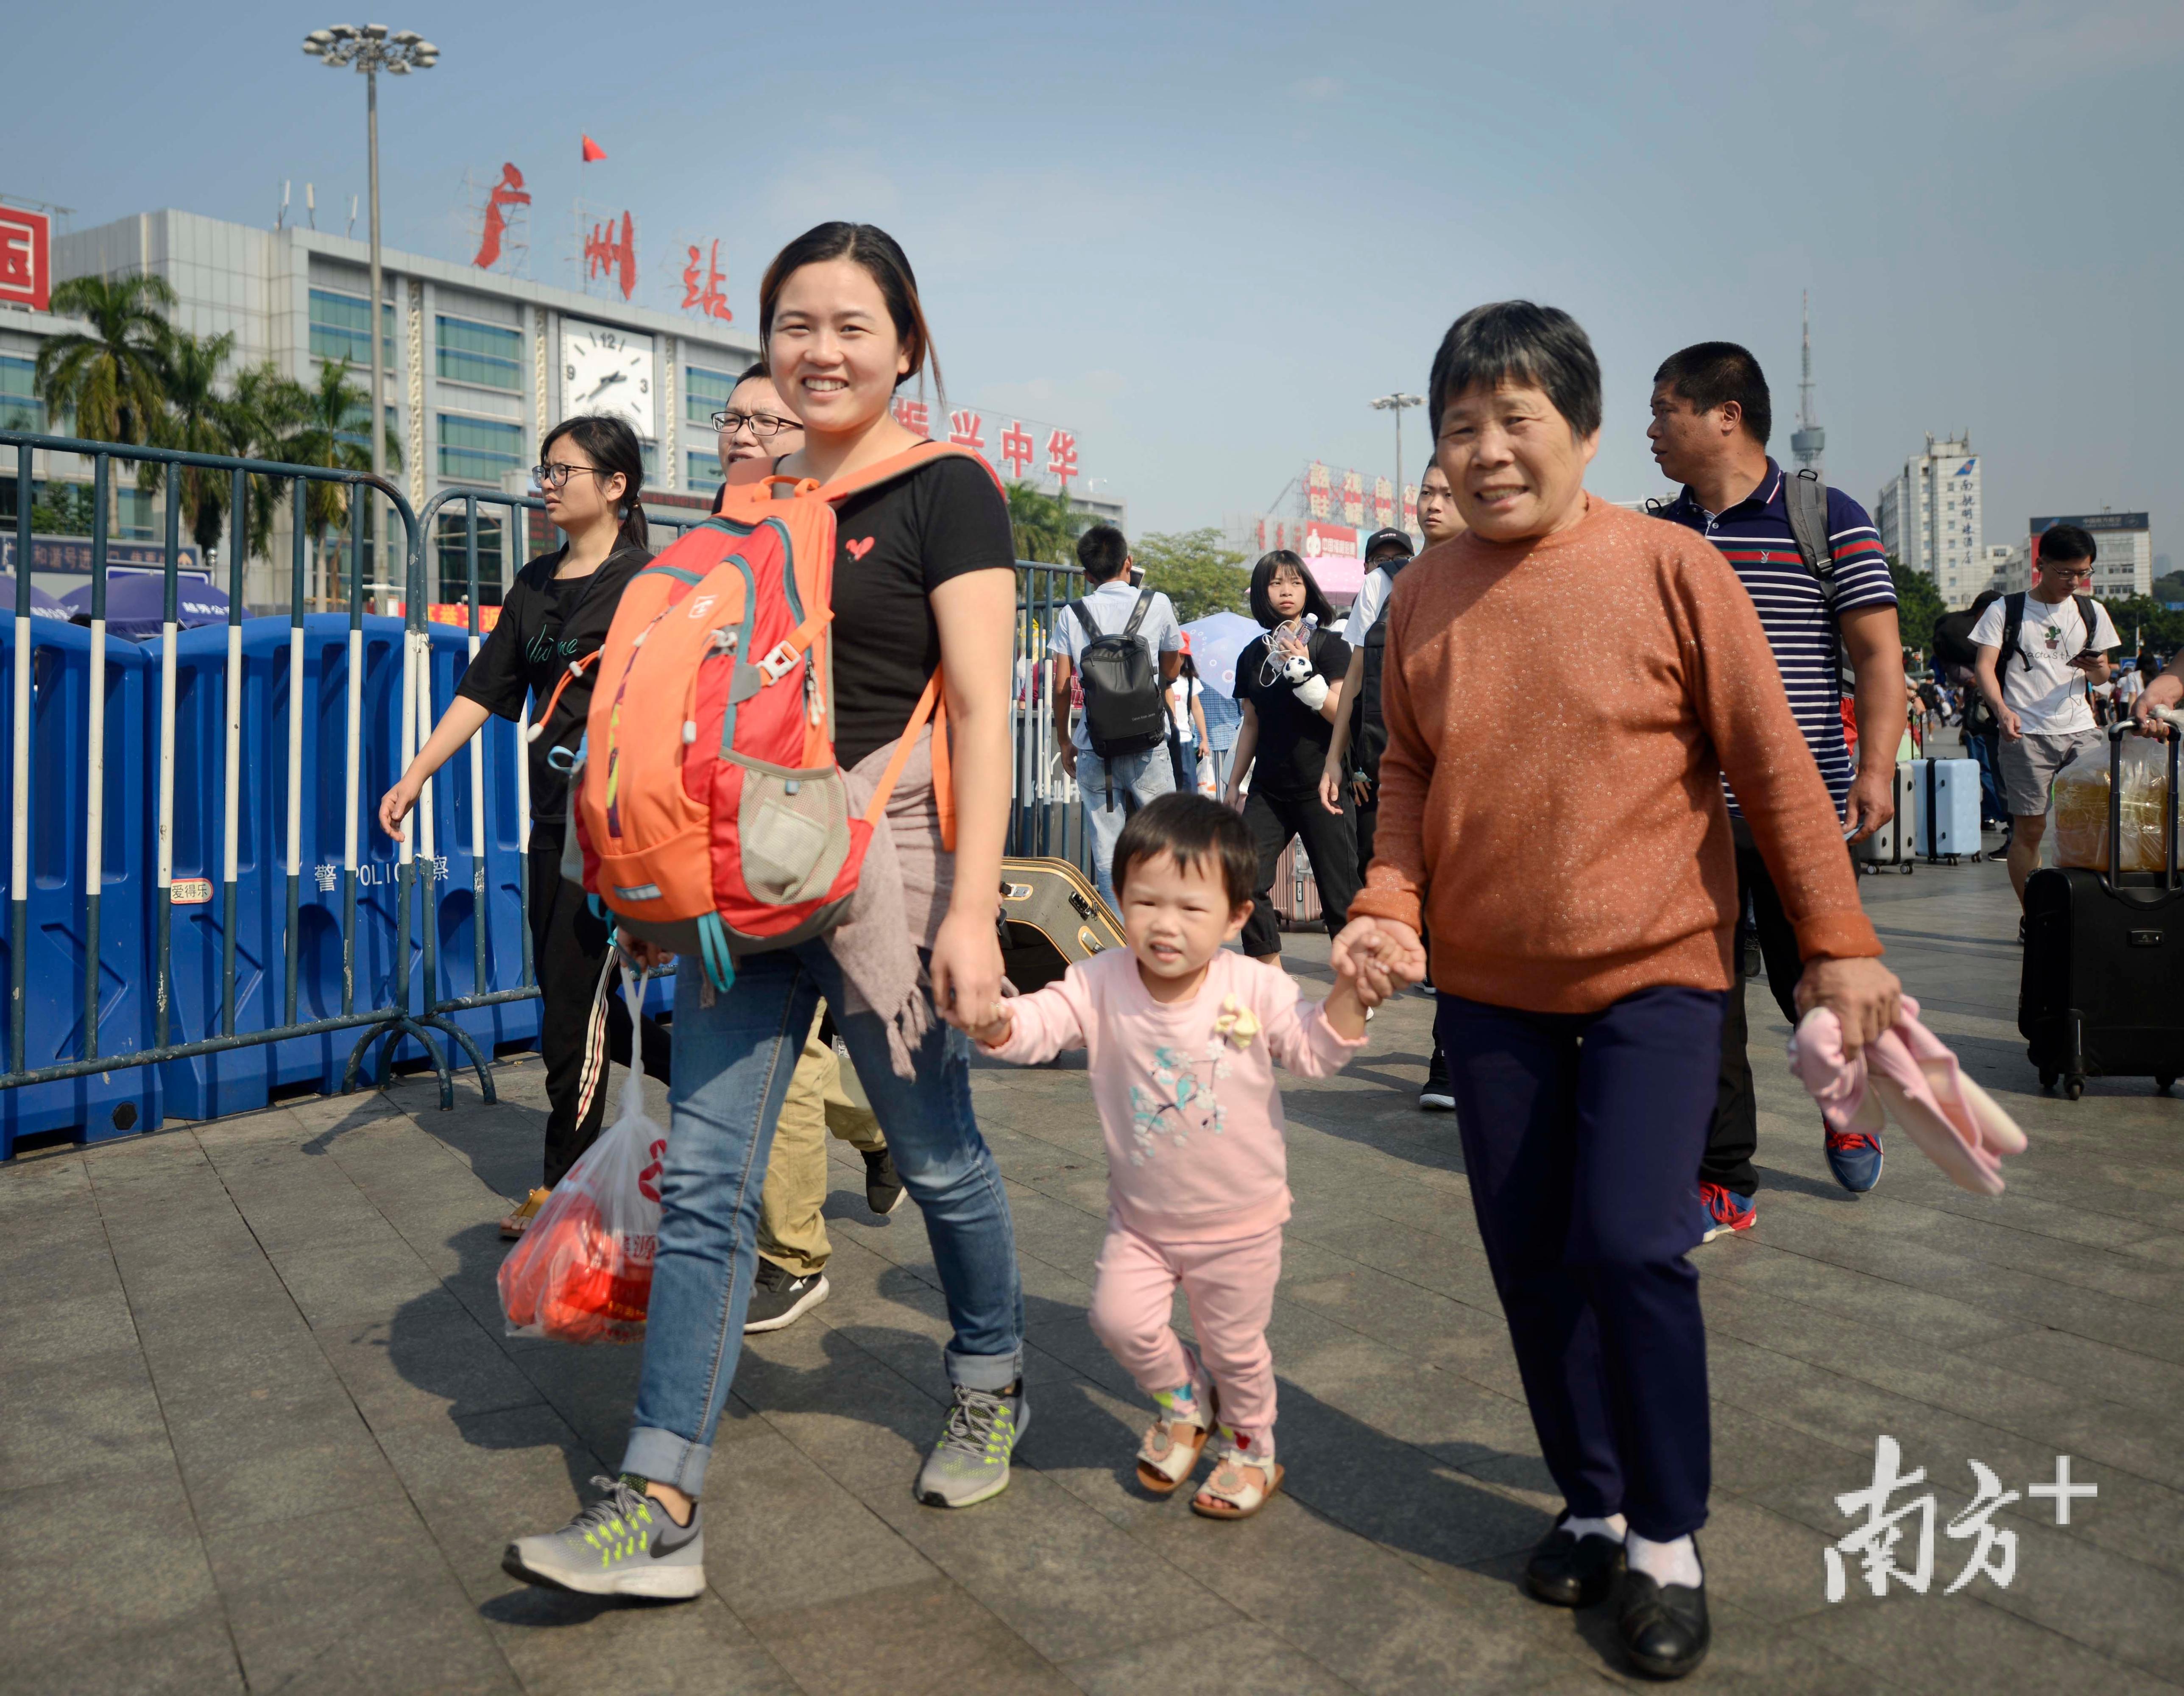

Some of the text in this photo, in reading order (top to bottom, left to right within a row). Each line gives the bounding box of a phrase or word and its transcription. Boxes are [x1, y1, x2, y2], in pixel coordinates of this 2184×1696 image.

[472, 162, 733, 322] 广州站
[600, 334, 615, 349] 12
[566, 365, 576, 380] 9
[640, 379, 649, 393] 3
[892, 395, 1079, 486] 振兴中华
[314, 863, 337, 892] 警
[172, 884, 207, 899] 爱得乐
